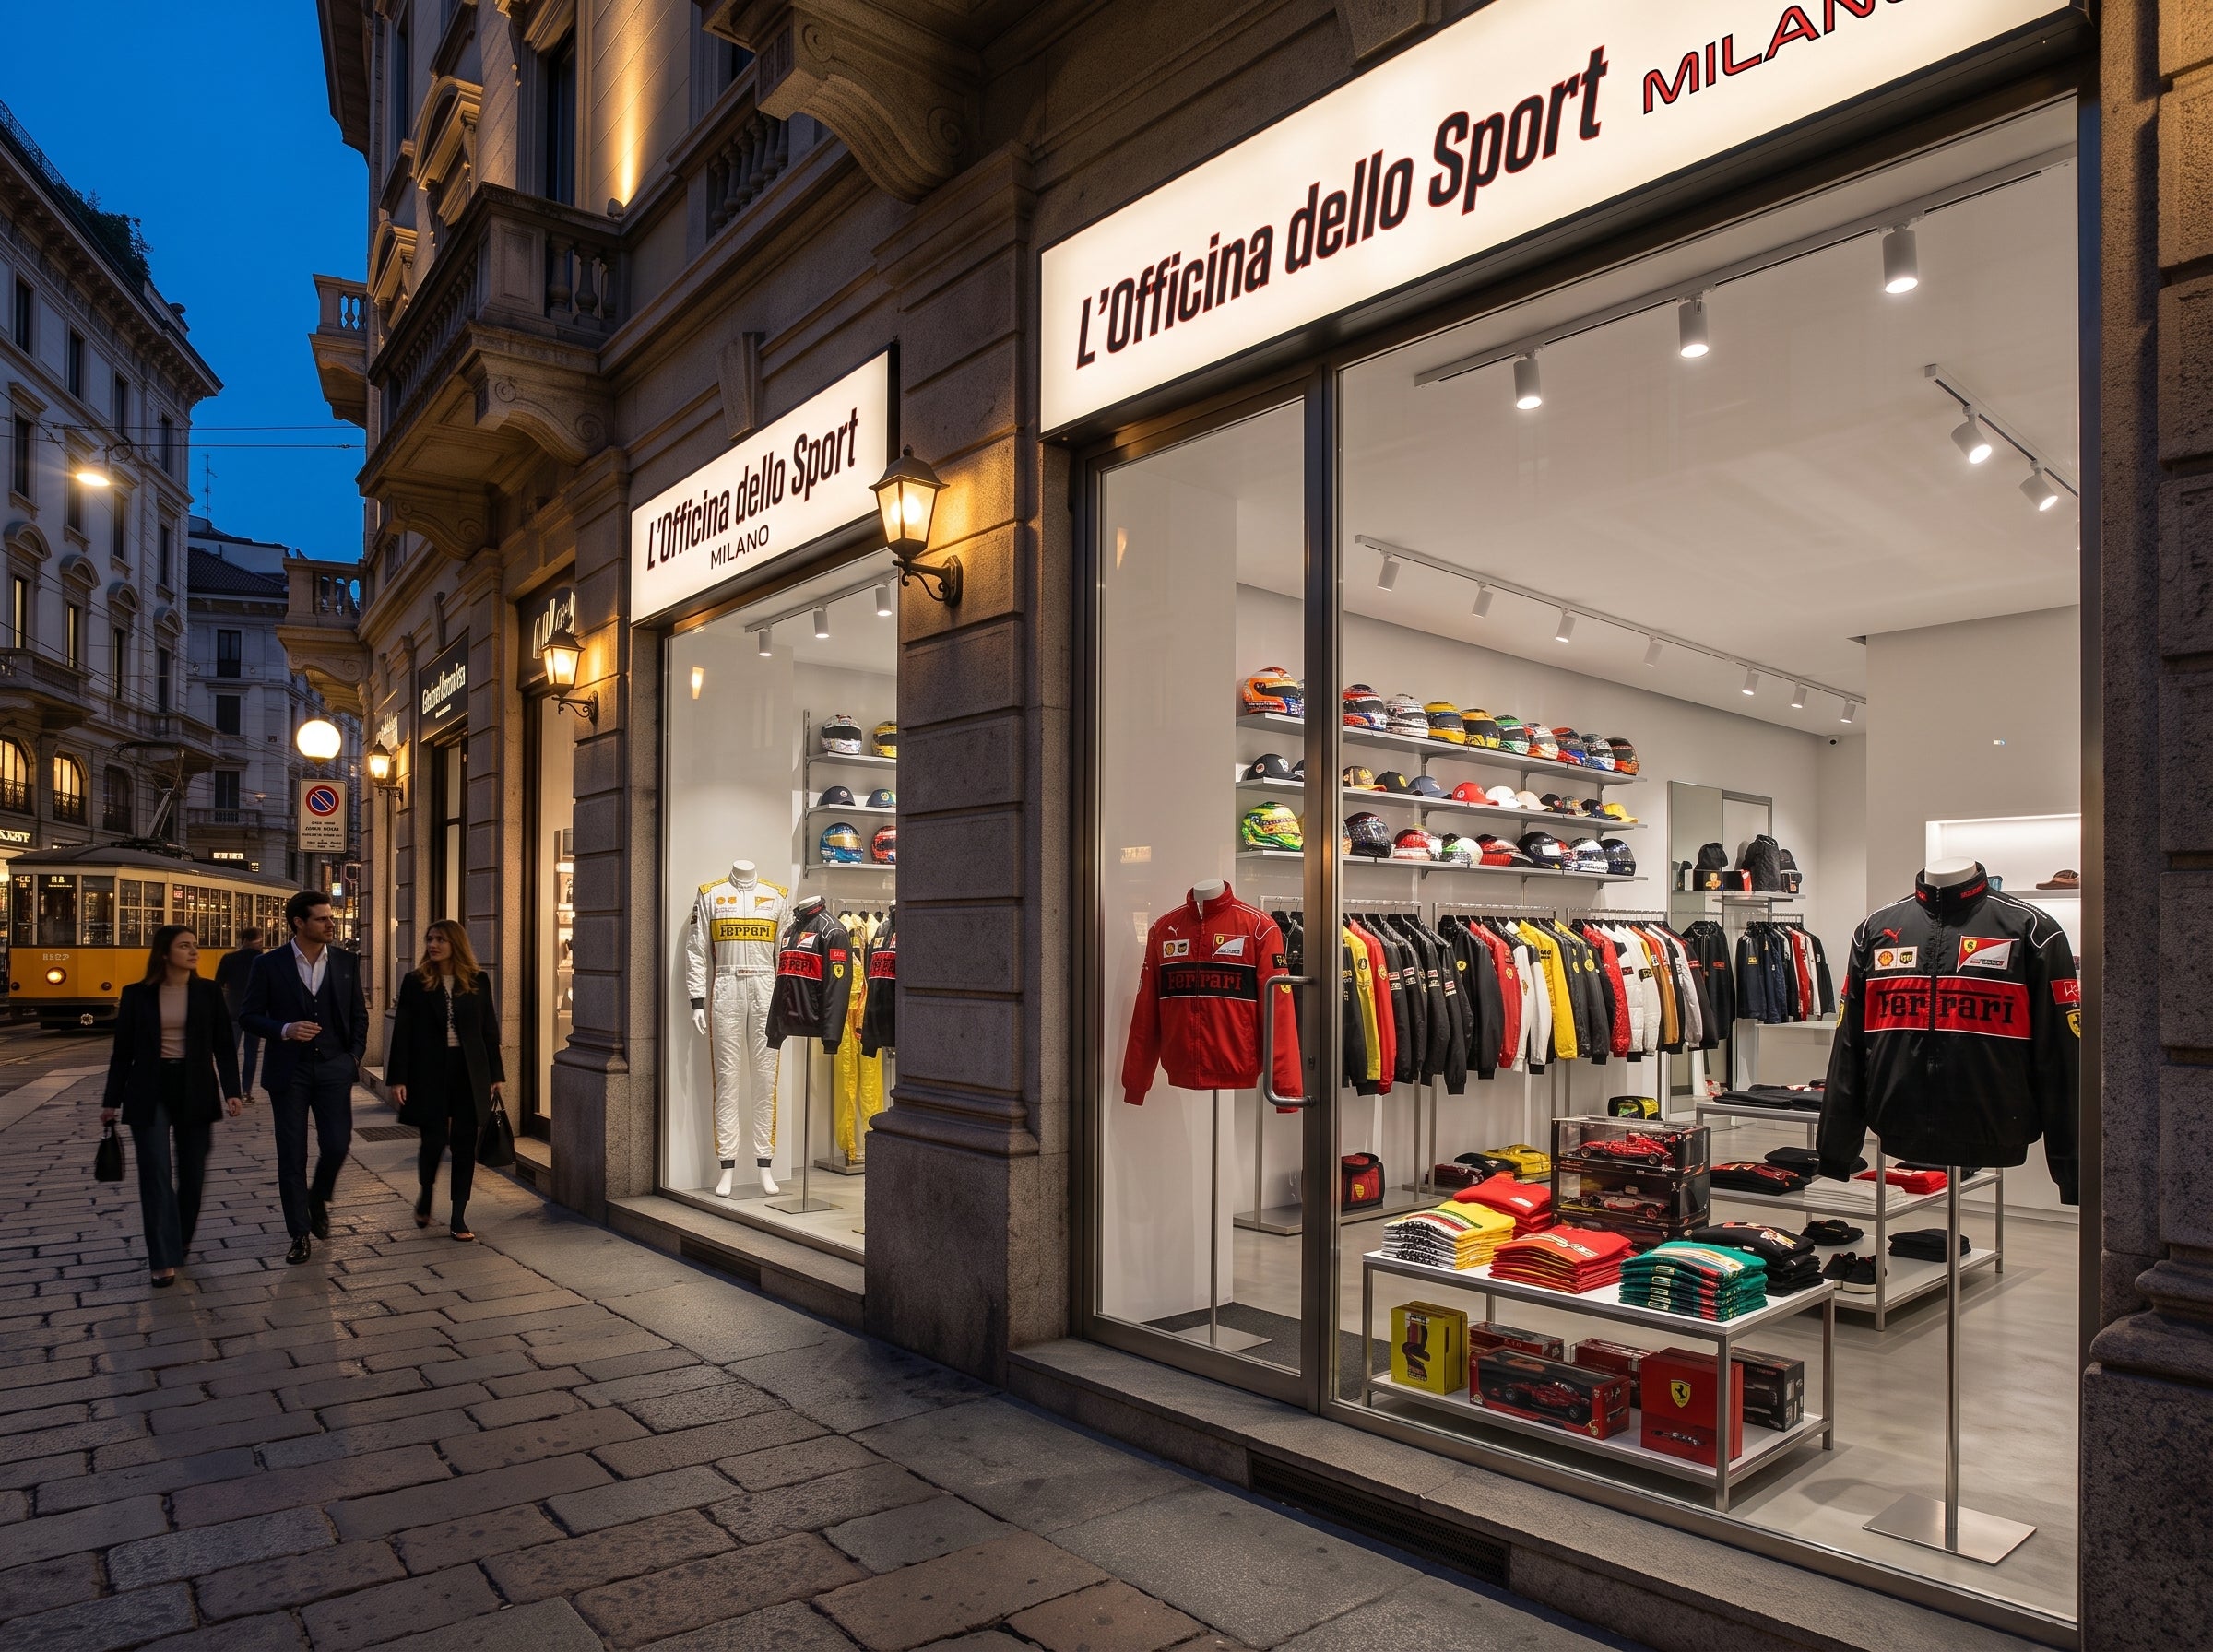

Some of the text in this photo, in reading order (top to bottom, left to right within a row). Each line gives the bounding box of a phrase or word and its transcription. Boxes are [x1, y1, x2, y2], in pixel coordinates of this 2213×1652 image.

[1075, 0, 1905, 371] L'Officina dello Sport MILAN
[646, 407, 858, 572] L'Officina dello Sport
[710, 525, 770, 570] MILANO
[1166, 970, 1242, 991] Ferrari
[1876, 987, 2015, 1025] Ferrari
